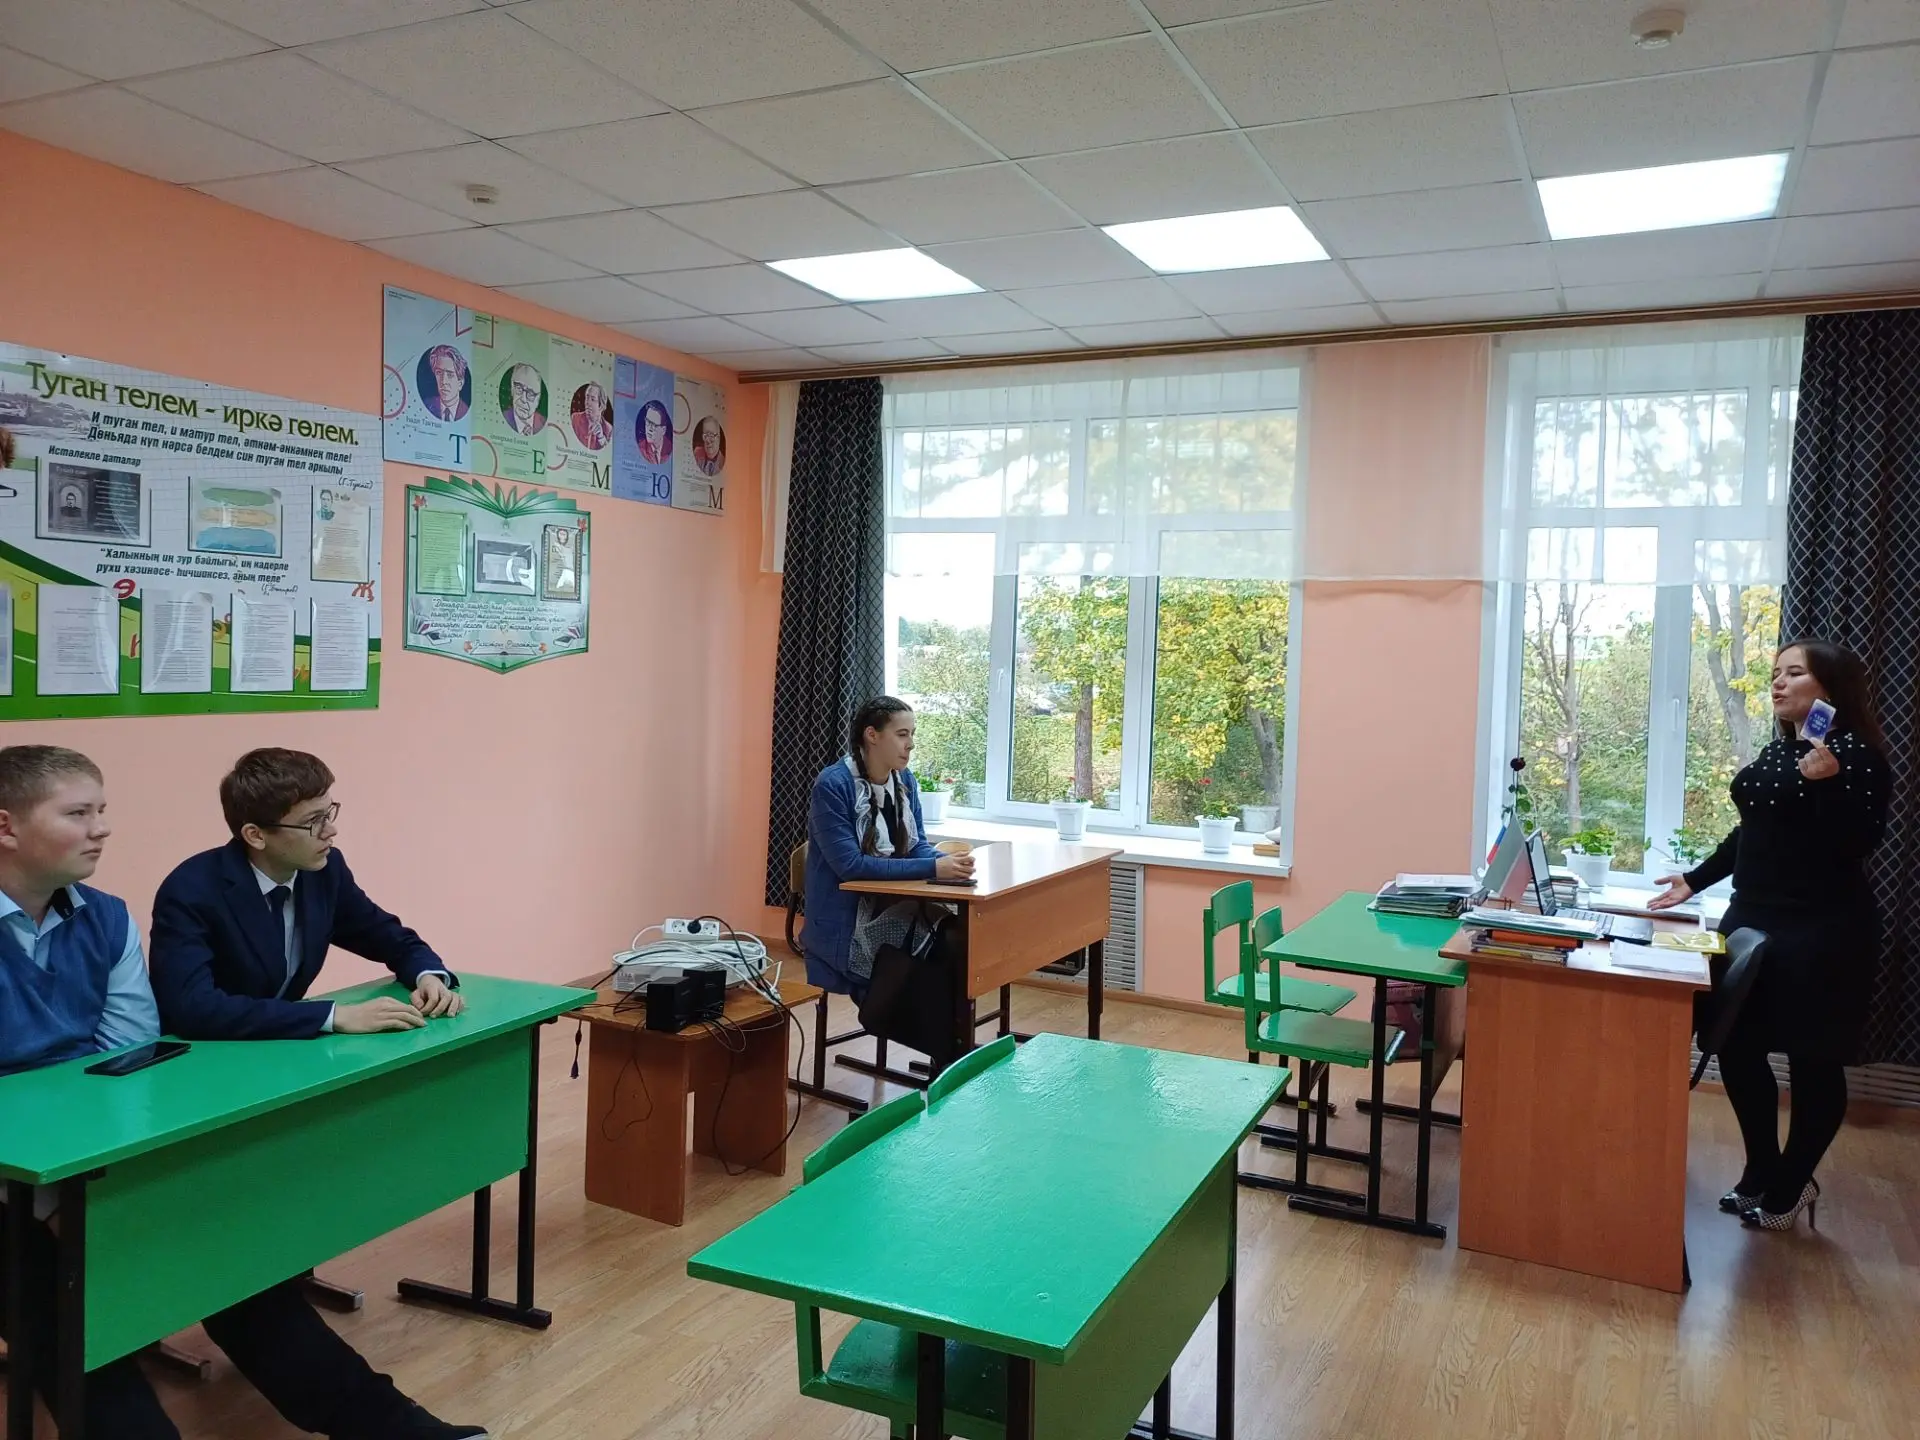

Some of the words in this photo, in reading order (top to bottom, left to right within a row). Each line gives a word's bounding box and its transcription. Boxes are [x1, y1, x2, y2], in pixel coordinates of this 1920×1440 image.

[26, 361, 109, 402] Туган
[114, 385, 198, 418] телем
[222, 404, 283, 433] иркә
[288, 417, 359, 446] гөлем.
[91, 411, 100, 423] И
[102, 415, 139, 428] туган
[141, 421, 167, 435] тел,
[170, 426, 178, 435] и
[179, 427, 215, 443] матур
[217, 433, 241, 447] тел,
[101, 453, 142, 468] даталар
[195, 442, 235, 459] белдем
[236, 450, 254, 462] син
[255, 453, 285, 466] туган
[286, 458, 306, 470] тел
[307, 462, 344, 475] аркылы
[449, 433, 468, 464] Т
[532, 448, 546, 475] Е
[590, 461, 611, 490] М
[650, 472, 671, 499] Ю
[708, 484, 724, 510] М
[96, 563, 121, 574] рухи
[176, 555, 192, 565] зур
